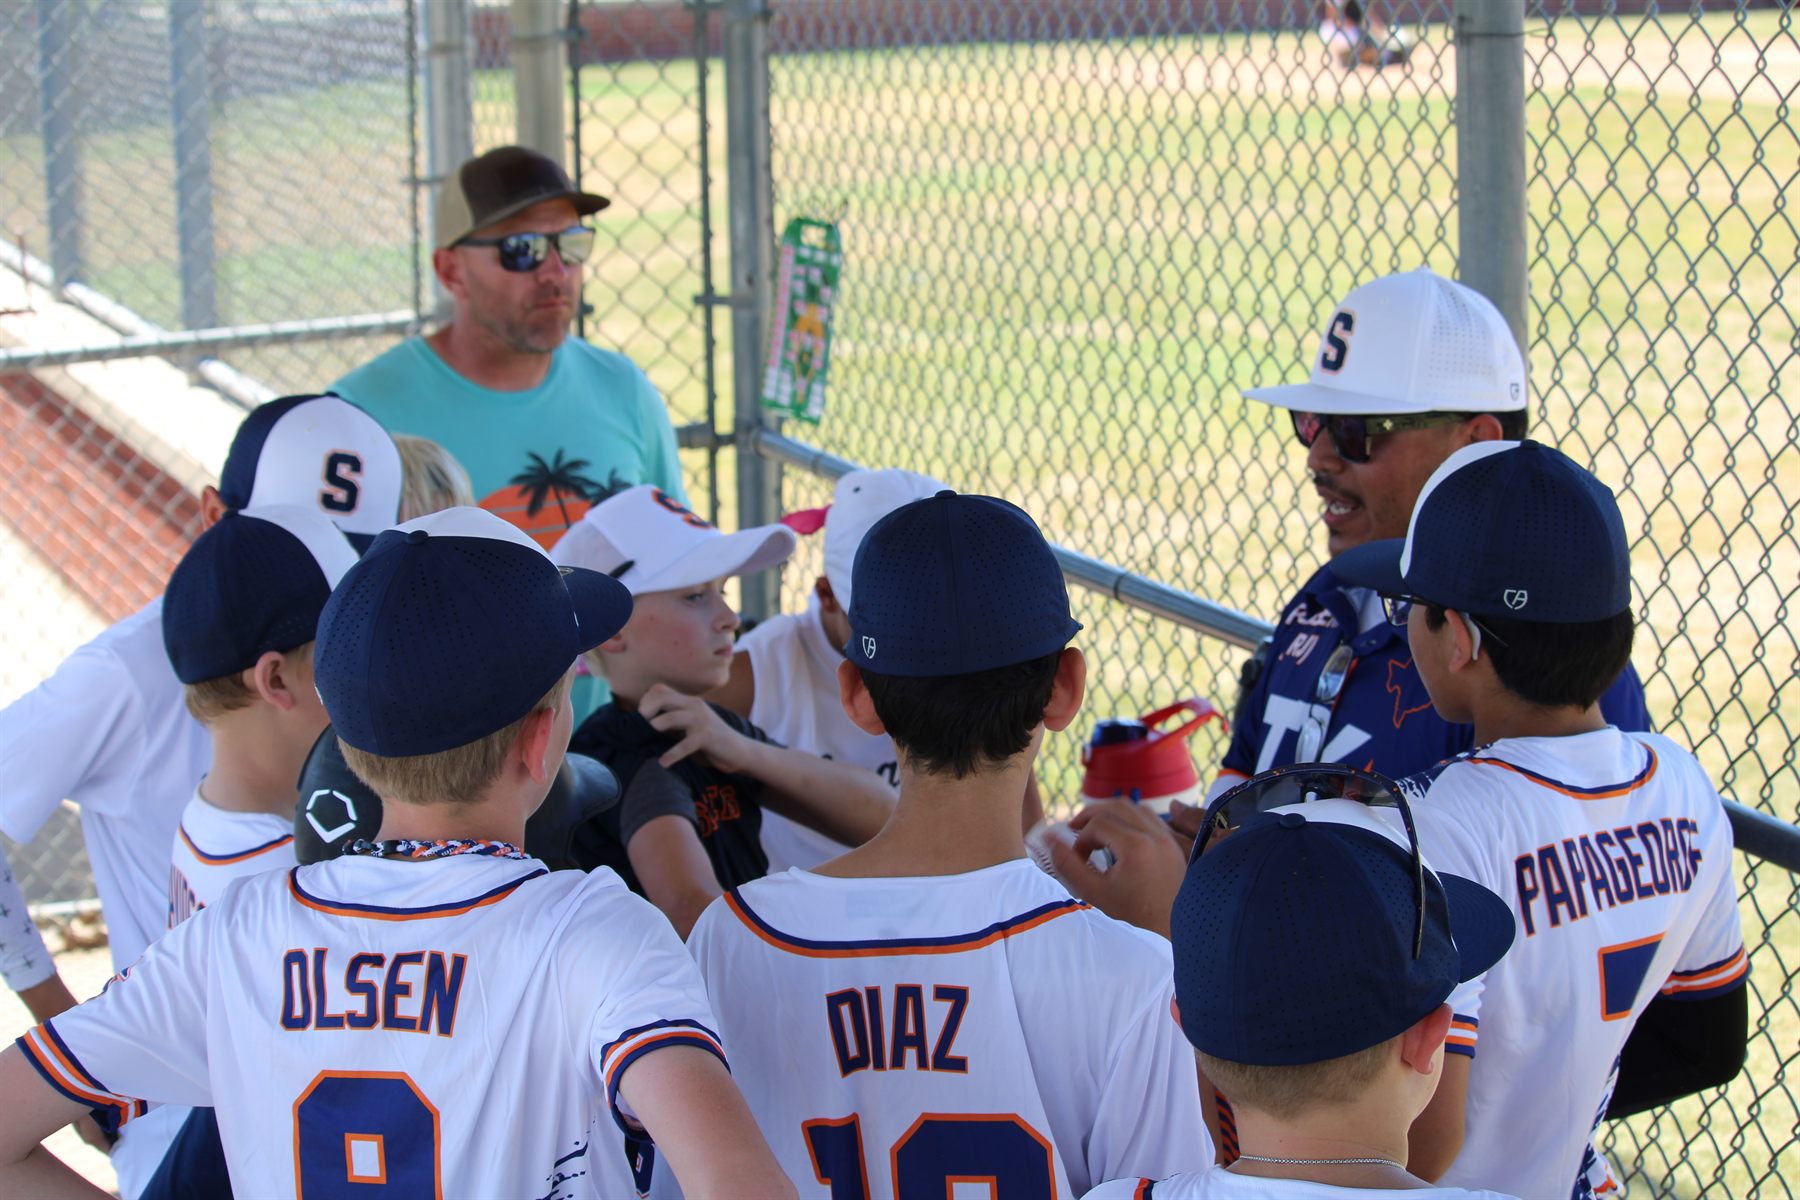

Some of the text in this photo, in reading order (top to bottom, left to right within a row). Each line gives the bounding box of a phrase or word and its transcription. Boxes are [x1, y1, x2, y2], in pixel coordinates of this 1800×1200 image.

[1320, 307, 1357, 376] S
[316, 448, 366, 517] S
[280, 947, 468, 1038] OLSEN
[825, 983, 969, 1078] DIAZ
